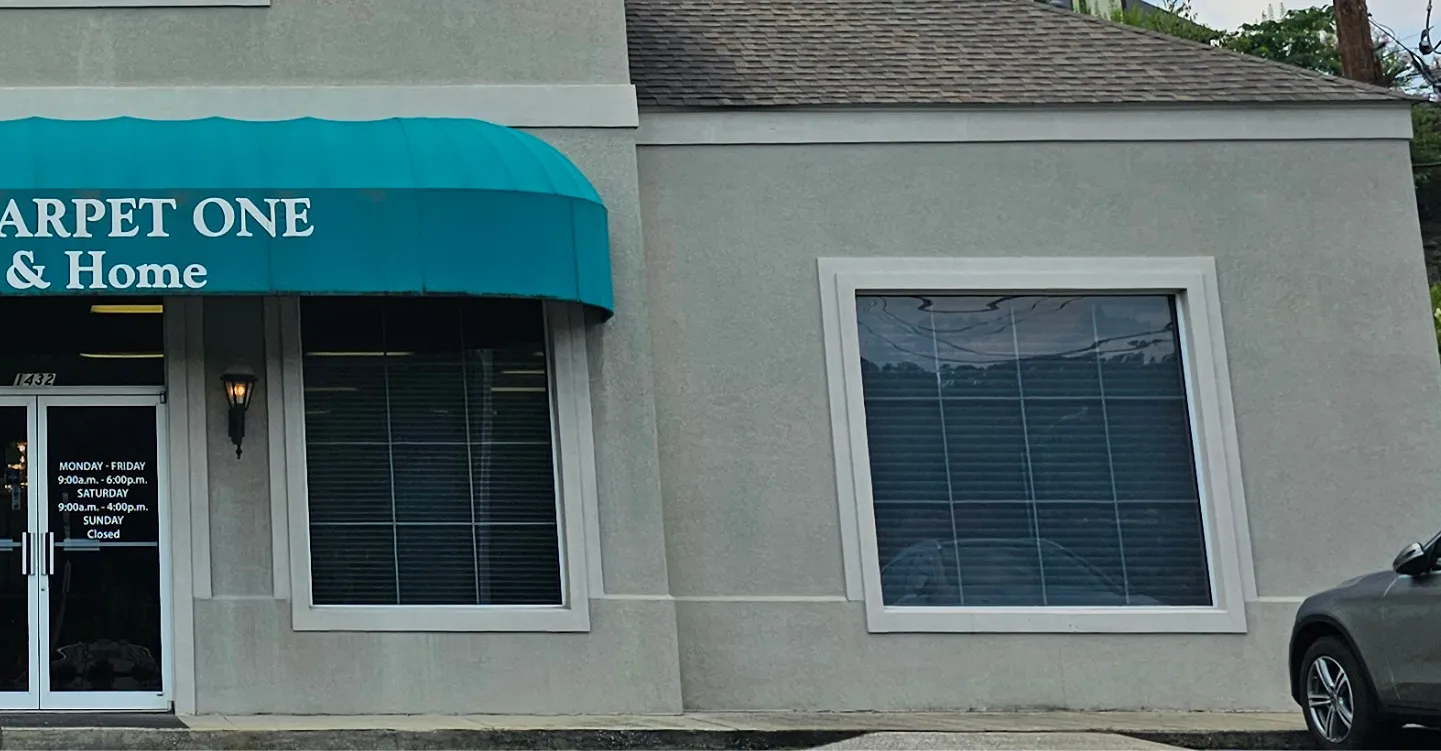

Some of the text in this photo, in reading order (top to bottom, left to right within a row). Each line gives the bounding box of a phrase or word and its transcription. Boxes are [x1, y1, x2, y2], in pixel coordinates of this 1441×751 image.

[193, 197, 315, 238] ONE
[6, 249, 52, 289] &
[64, 249, 208, 289] Home
[15, 373, 55, 386] 1432
[59, 461, 103, 471] MONDAY
[111, 461, 146, 471] FRIDAY
[57, 475, 99, 485] 9:00a.m.
[106, 475, 148, 486] 6:00p.m.
[77, 488, 128, 498] SATURDAY
[57, 502, 99, 512] 9:00a.m.
[106, 502, 149, 513] 4:00p.m.
[83, 516, 125, 526] SUNDAY
[87, 529, 121, 539] Closed
